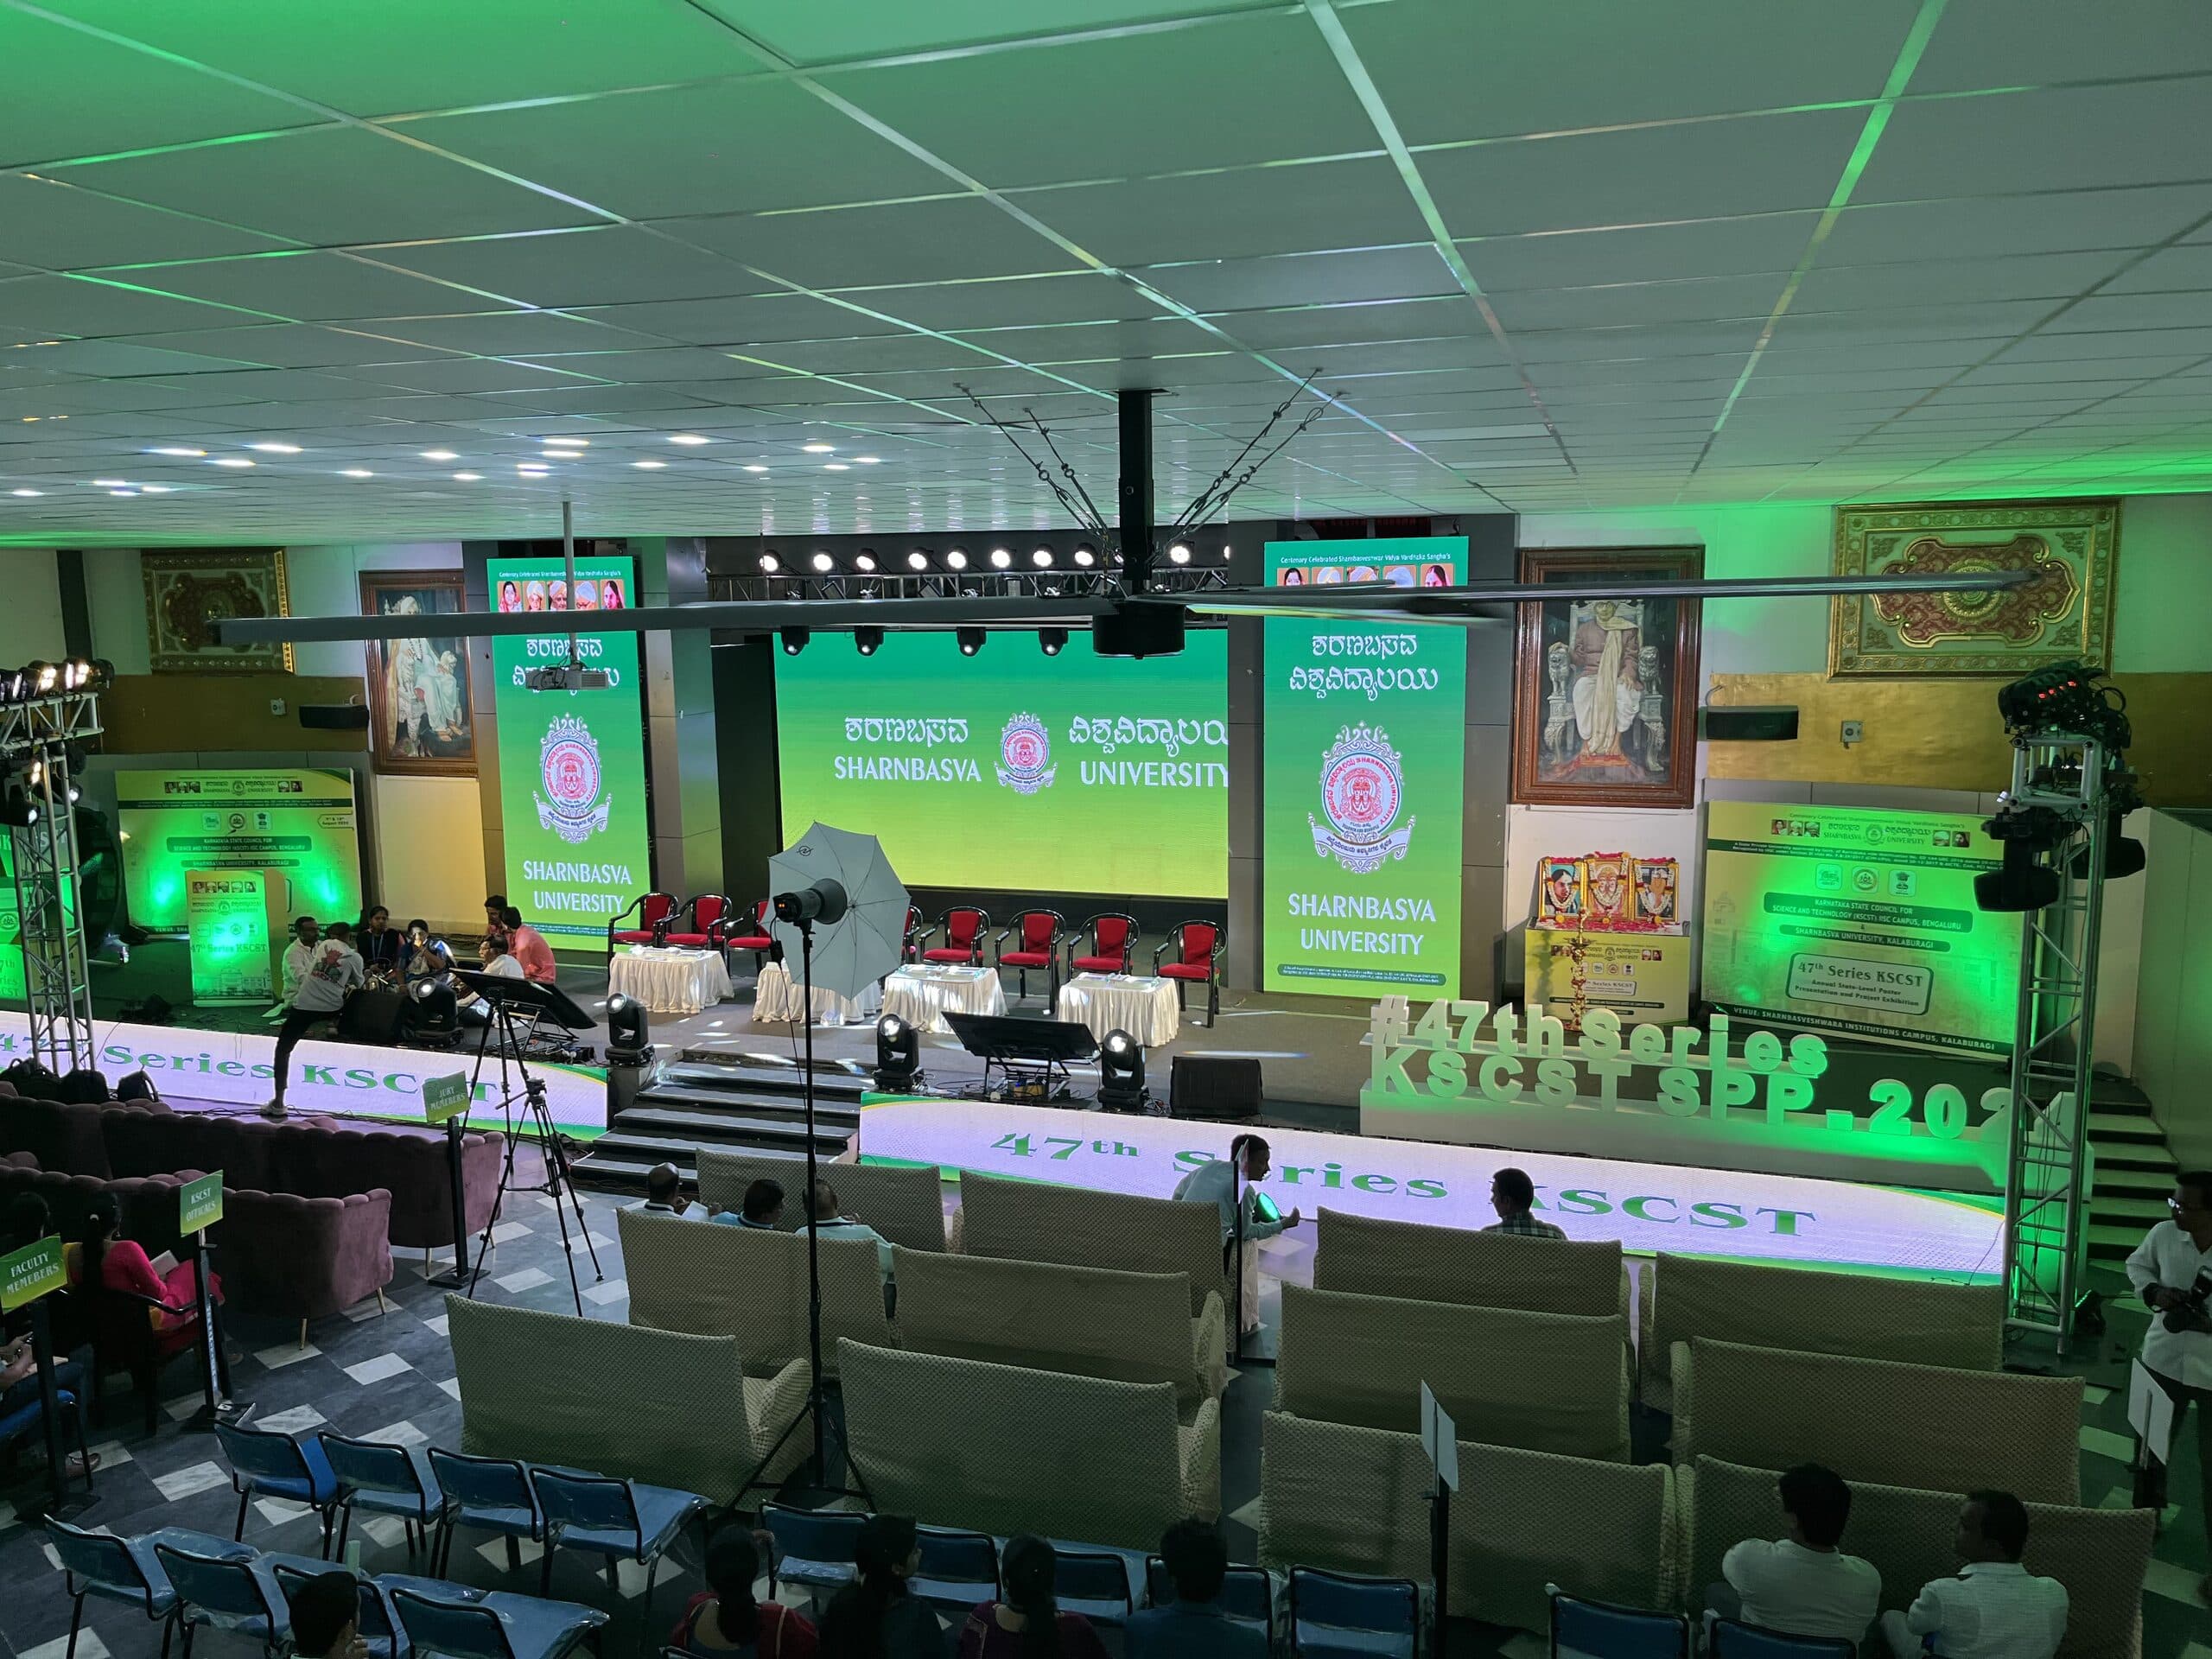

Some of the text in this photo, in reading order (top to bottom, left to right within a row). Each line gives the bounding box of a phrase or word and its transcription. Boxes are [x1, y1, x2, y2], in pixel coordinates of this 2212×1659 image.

[1313, 632, 1417, 660] ಶರಣಬಸವ
[1289, 665, 1439, 702] ವಿಶ್ವವಿದ್ಯಾಲಯ
[845, 715, 969, 748] ಶರಣಬಸವ
[834, 755, 982, 782] SHARNBASVA
[523, 860, 632, 885] SHARNBASVA
[534, 890, 624, 913] UNIVERSITY
[1288, 893, 1436, 923] SHARNBASVA
[1815, 899, 1850, 907] KARNATAKA
[1812, 909, 1852, 918] TECHNOLOGY
[1922, 919, 1961, 930] BENGALURU
[1300, 928, 1424, 956] UNIVERSITY
[1796, 927, 1840, 938] SHARNBASVA
[1886, 938, 1934, 948] KALABURAGI
[1827, 965, 1872, 981] Series
[1877, 971, 1923, 987] KSCST
[1733, 1007, 1995, 1051] VENUE: SHARNBASVESHWARA INSTITUTIONS CAMPUS, KALABURAGI
[103, 1046, 276, 1079] Series
[302, 1064, 498, 1102] KSCT
[1370, 1042, 1633, 1112] KSCST
[990, 1133, 1139, 1160] 47th
[1173, 1150, 1448, 1198] Sries
[191, 1187, 212, 1205] KSCST
[10, 1250, 49, 1278] FACULTY
